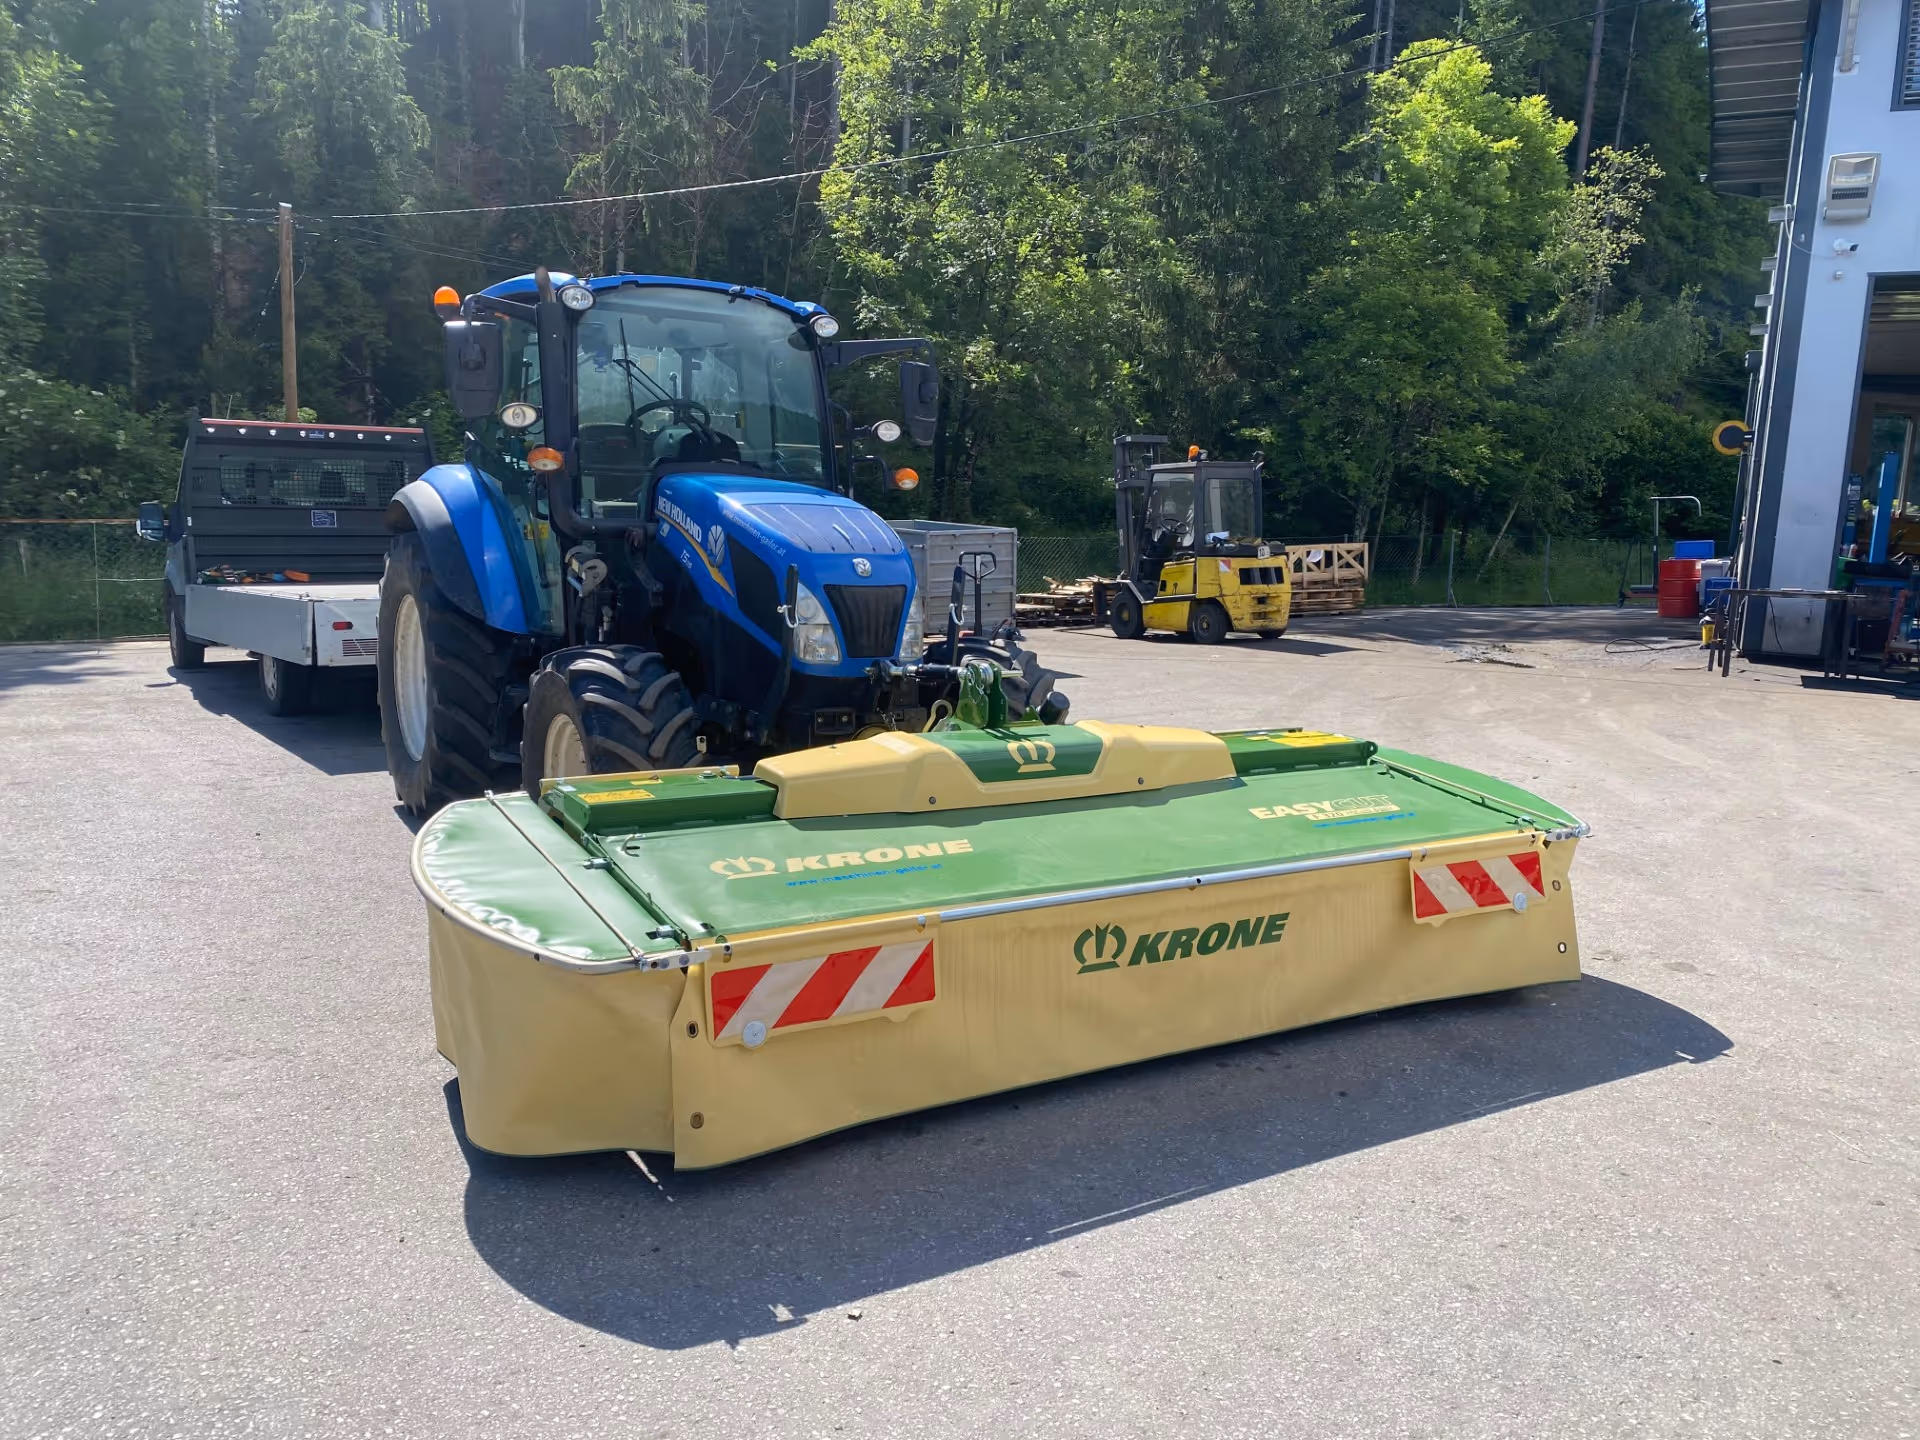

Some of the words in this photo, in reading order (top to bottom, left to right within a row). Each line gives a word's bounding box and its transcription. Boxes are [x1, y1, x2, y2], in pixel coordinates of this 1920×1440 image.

[658, 496, 671, 516] NEW
[671, 503, 702, 543] HOLLAND
[785, 839, 974, 873] KRONE
[1127, 912, 1290, 967] KRONE
